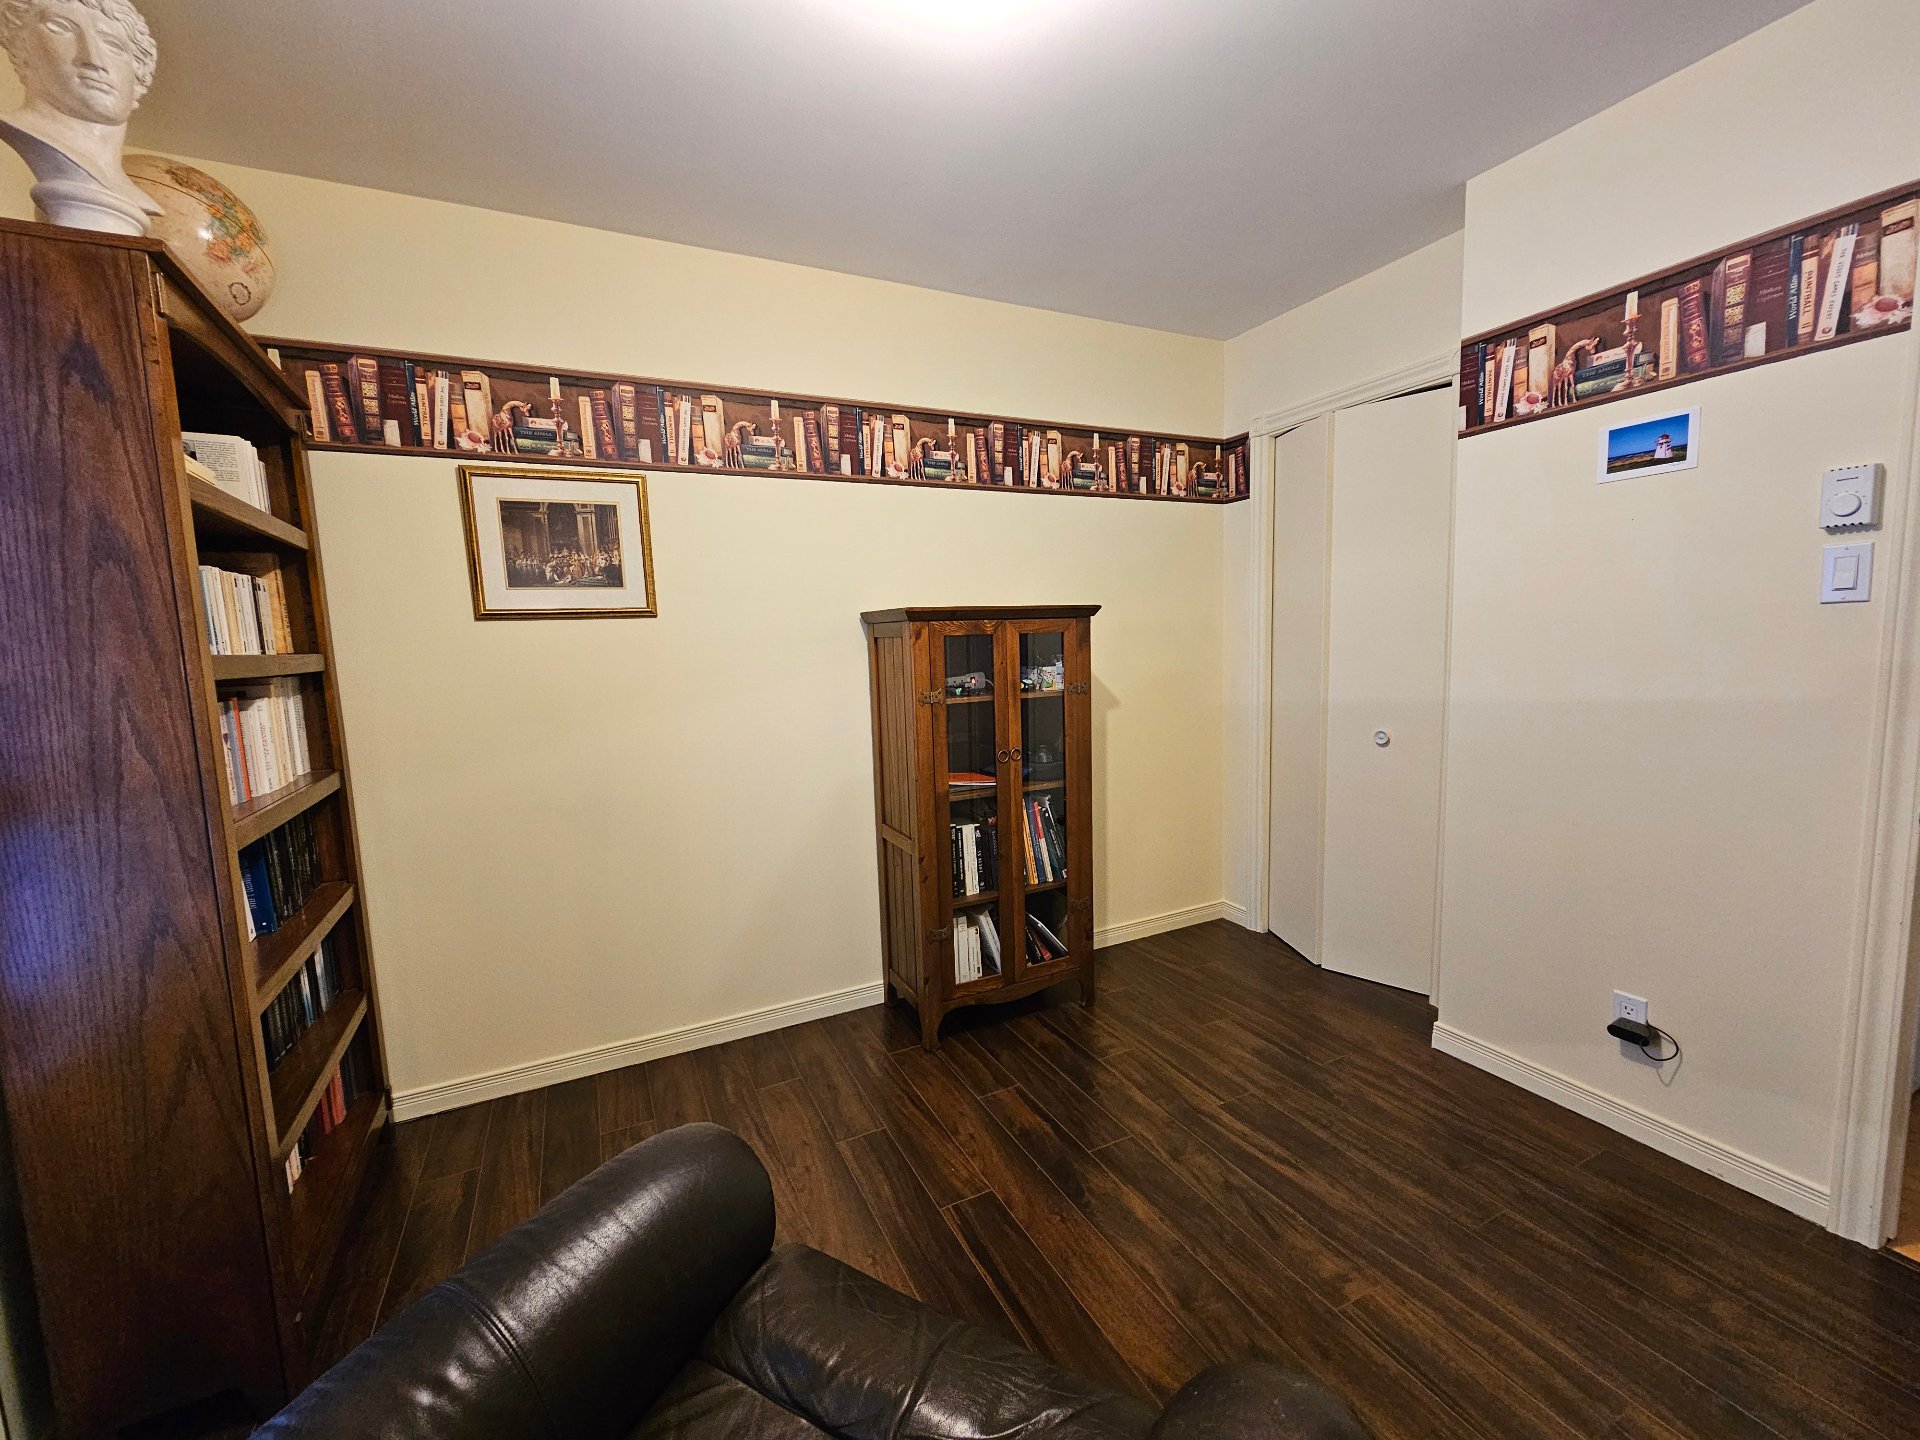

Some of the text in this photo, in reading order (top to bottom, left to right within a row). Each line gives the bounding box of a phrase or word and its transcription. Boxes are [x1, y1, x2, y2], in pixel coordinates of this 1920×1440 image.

[1788, 274, 1799, 320] World Atlas
[1802, 270, 1814, 316] PAINTBALL
